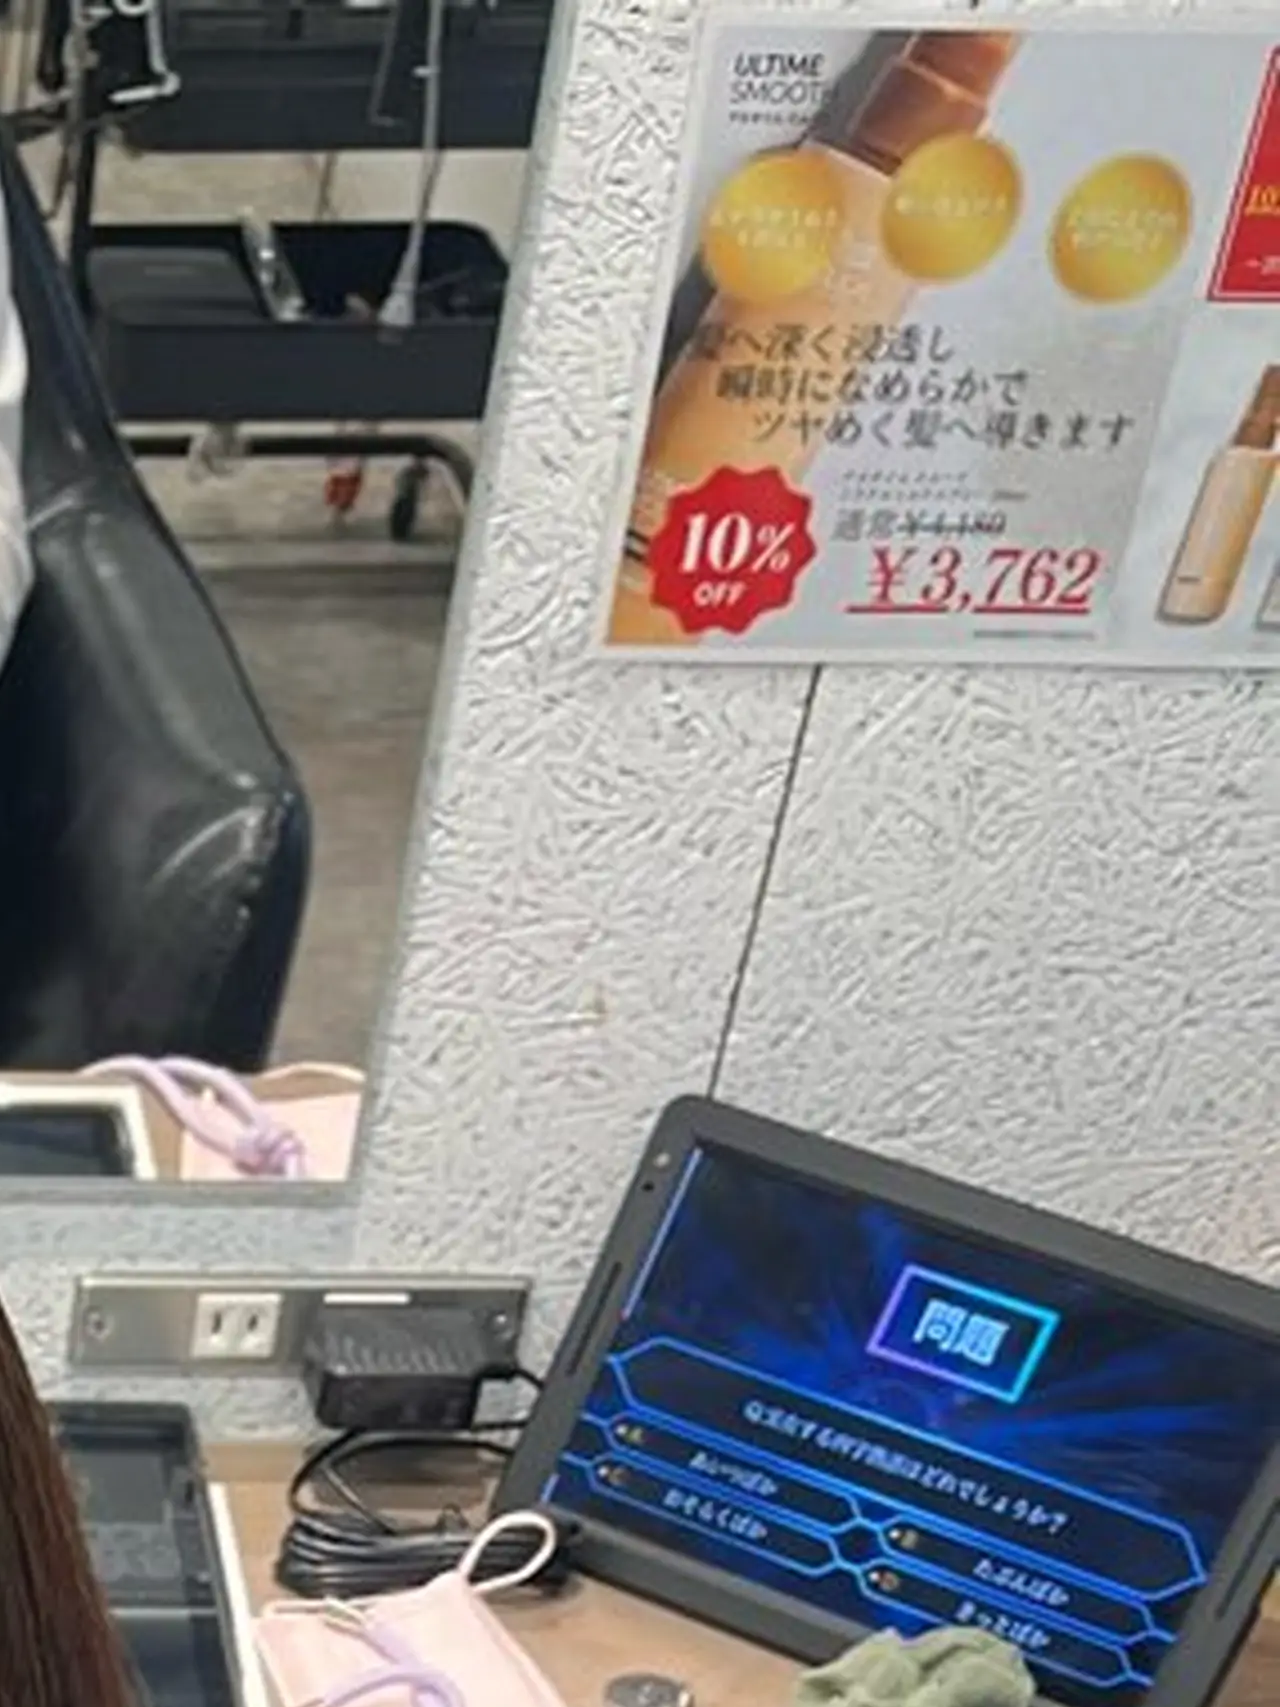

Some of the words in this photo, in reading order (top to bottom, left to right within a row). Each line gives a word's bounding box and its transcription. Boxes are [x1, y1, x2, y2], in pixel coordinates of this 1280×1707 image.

[734, 52, 826, 77] ULTIME
[679, 512, 796, 574] 10%
[692, 581, 746, 607] OFF
[867, 546, 1101, 612] ¥3,762
[913, 1298, 1010, 1367] 問題
